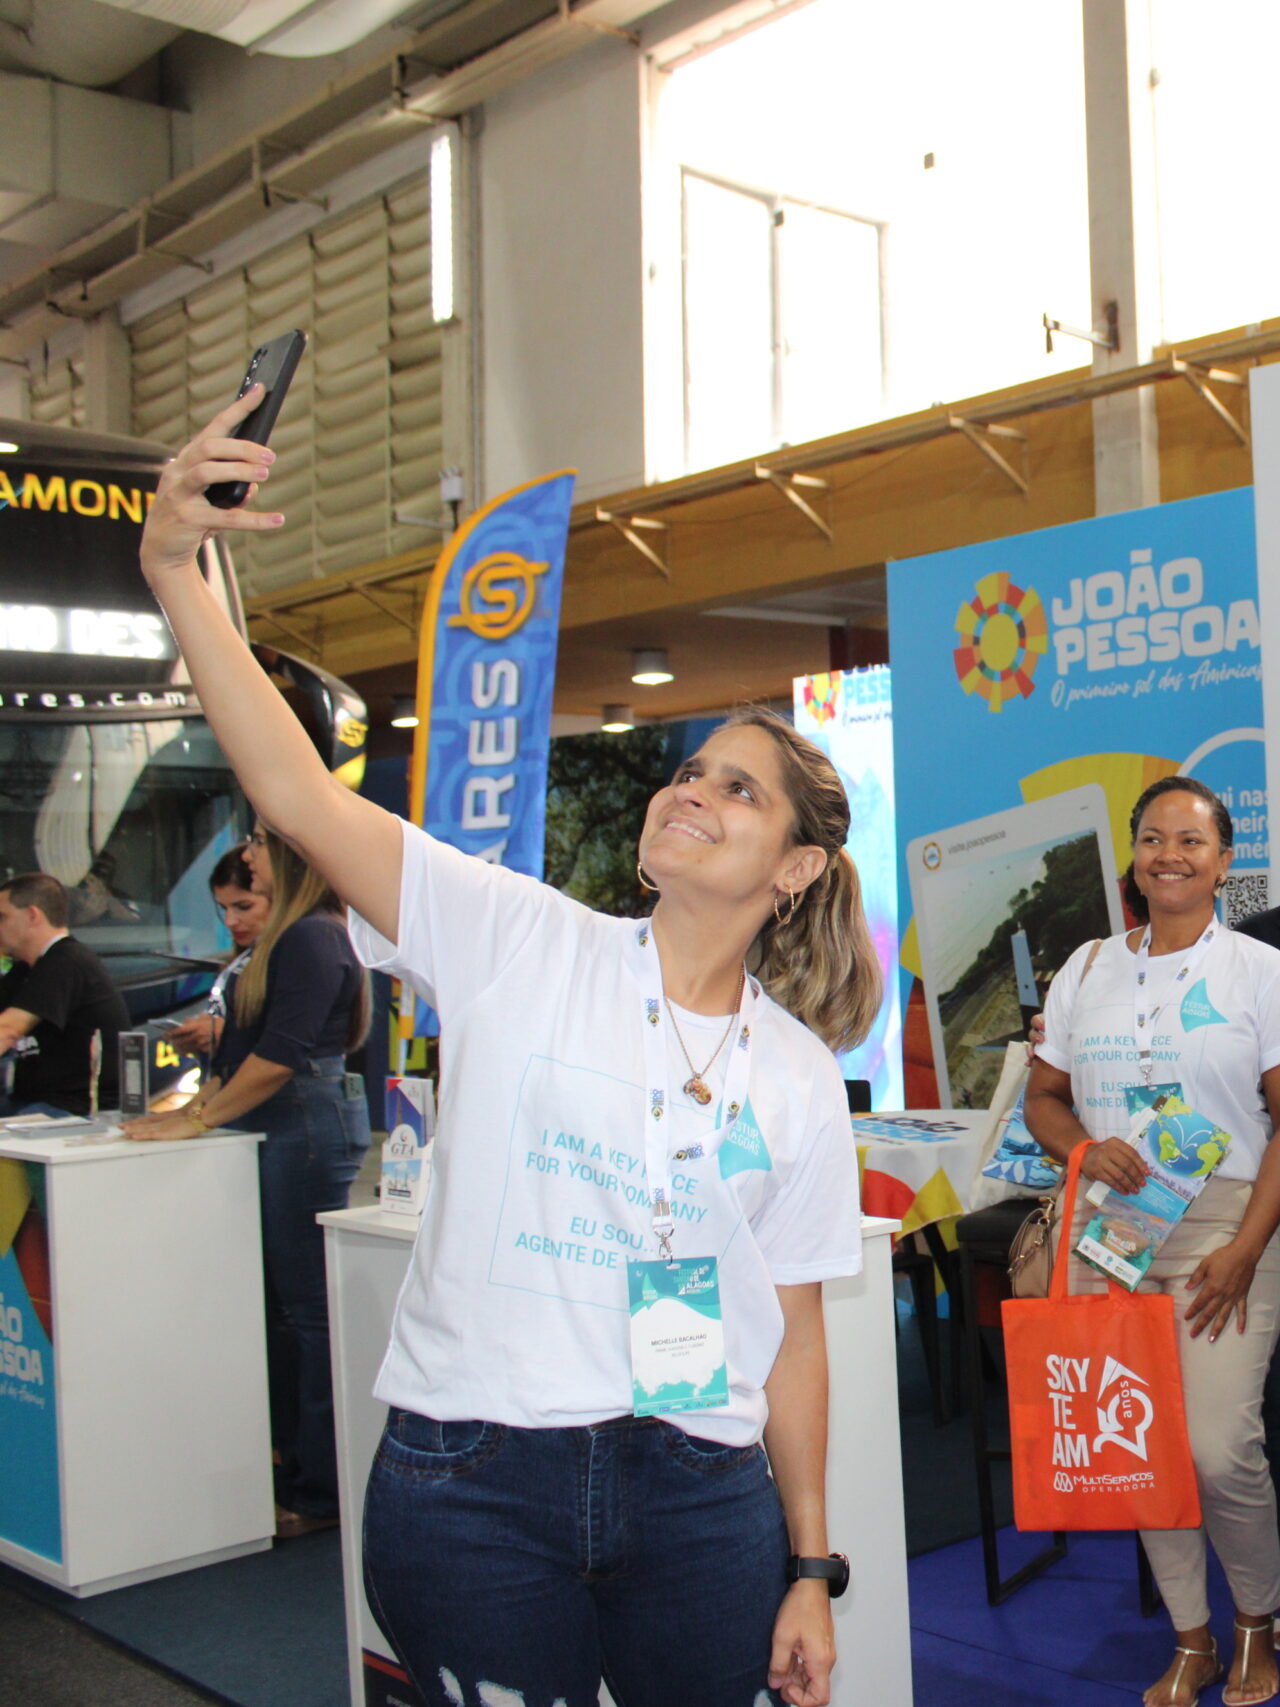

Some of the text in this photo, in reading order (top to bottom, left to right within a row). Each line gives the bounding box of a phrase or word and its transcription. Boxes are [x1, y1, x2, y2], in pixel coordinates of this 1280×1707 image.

[1052, 548, 1204, 627] JOÃO
[1052, 598, 1262, 676] PESSOA
[1084, 1036, 1100, 1048] AM
[1103, 1035, 1111, 1045] A
[1091, 1051, 1123, 1062] YOUR
[1126, 1051, 1181, 1062] COPANY
[390, 1143, 414, 1157] GTA
[554, 1131, 586, 1154] AM
[590, 1142, 603, 1160] A
[608, 1147, 639, 1174] KEY
[526, 1151, 560, 1175] FOR
[567, 1159, 619, 1193] YOUR
[570, 1216, 598, 1238] EU
[514, 1231, 619, 1270] AGENTE DE
[1045, 1353, 1091, 1393] SKY
[1048, 1392, 1077, 1430] TE
[1120, 1379, 1133, 1419] anos
[1051, 1431, 1091, 1469] AM
[1082, 1482, 1156, 1494] OPERADORA
